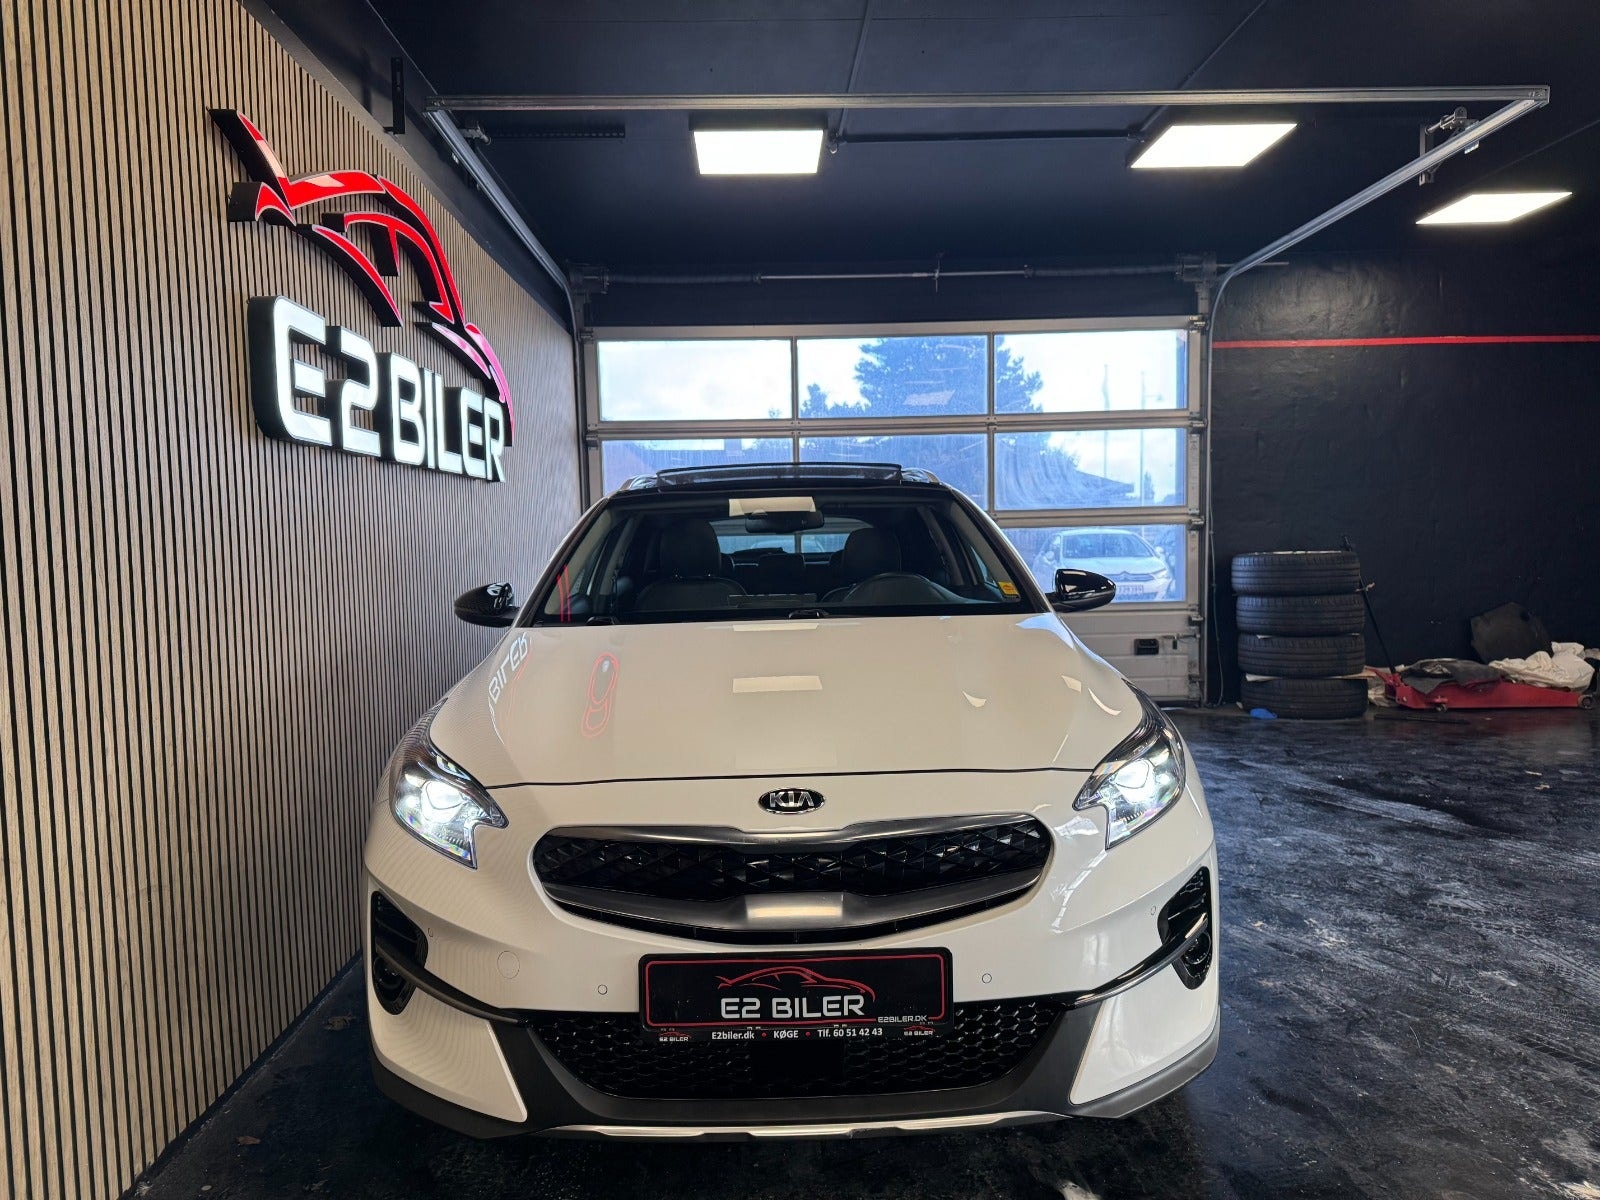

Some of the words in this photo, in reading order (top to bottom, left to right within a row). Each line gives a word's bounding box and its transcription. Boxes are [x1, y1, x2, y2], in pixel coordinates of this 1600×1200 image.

[390, 351, 506, 483] BILER
[769, 791, 814, 808] KIA
[720, 997, 761, 1019] E2
[772, 994, 865, 1019] BILER
[877, 1014, 928, 1024] E2BILER.DK
[711, 1031, 755, 1041] E2biler.dk
[773, 1029, 799, 1040] KØGE
[817, 1029, 831, 1038] Tlf.
[833, 1029, 844, 1038] 60
[846, 1028, 857, 1038] 51
[859, 1027, 870, 1037] 42
[872, 1027, 883, 1037] 43
